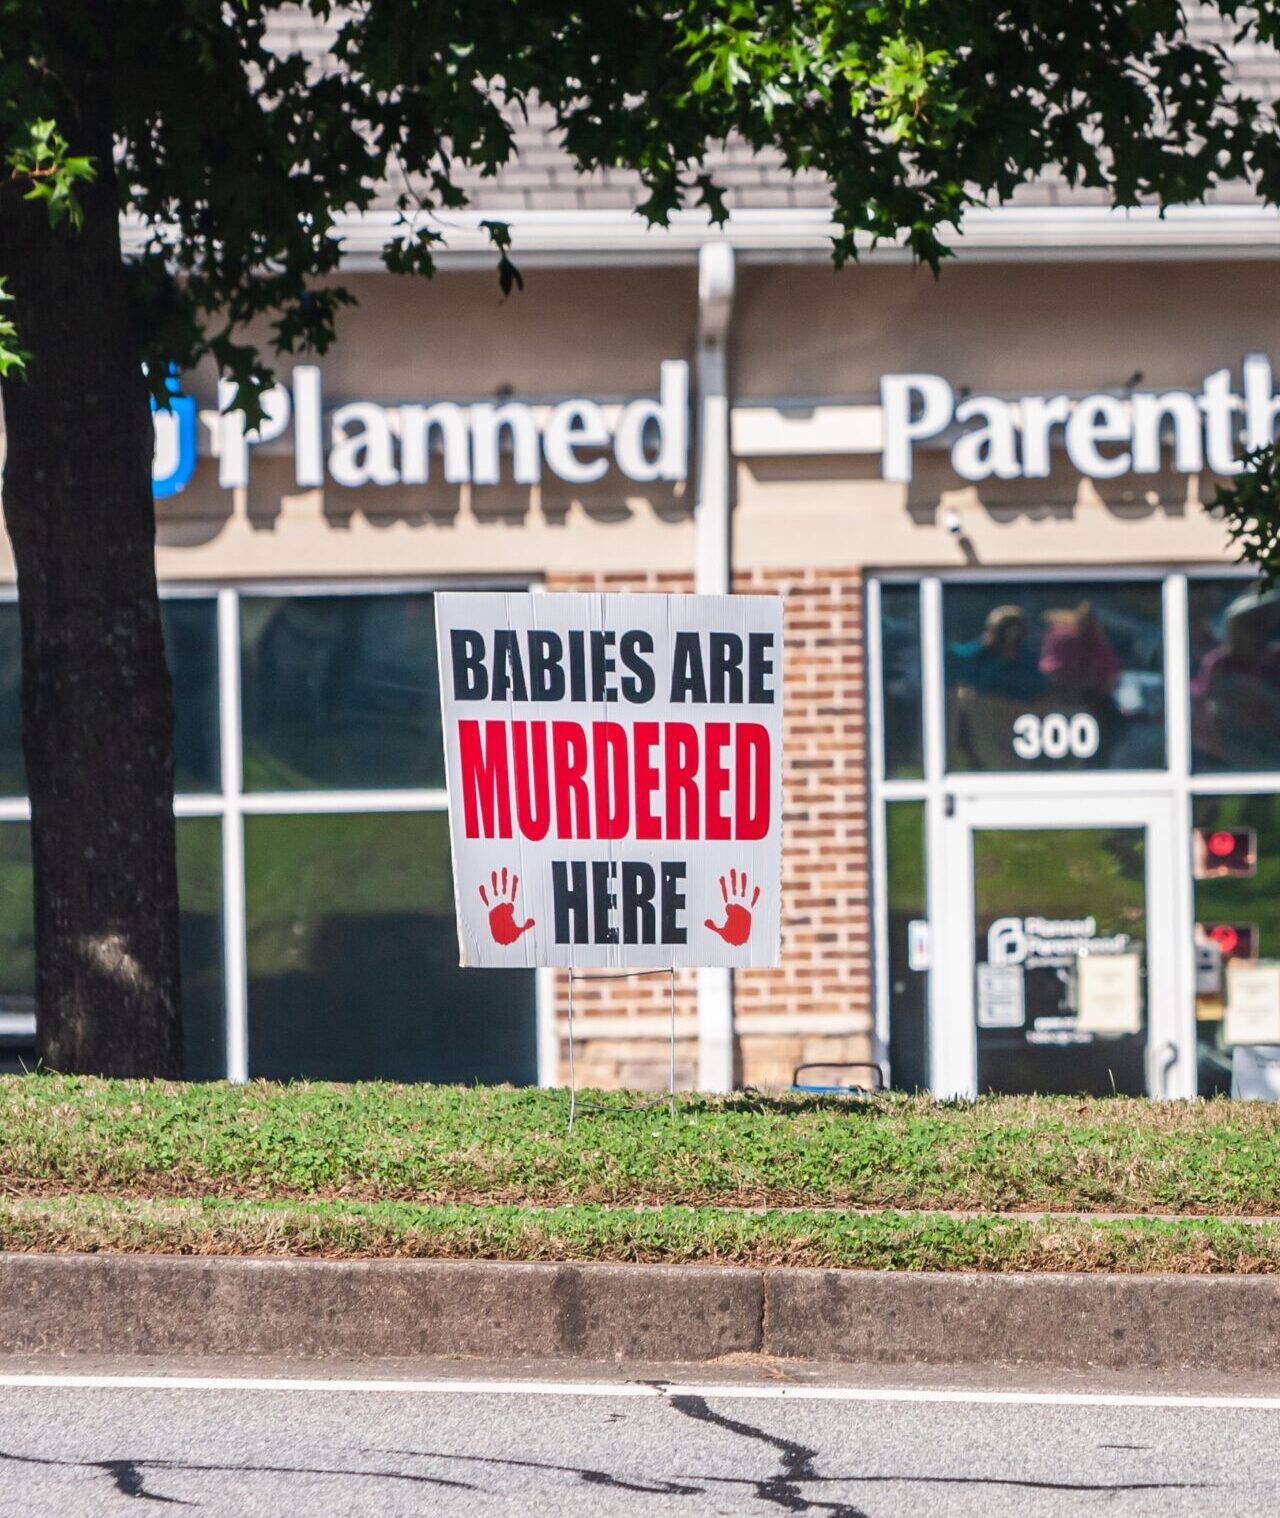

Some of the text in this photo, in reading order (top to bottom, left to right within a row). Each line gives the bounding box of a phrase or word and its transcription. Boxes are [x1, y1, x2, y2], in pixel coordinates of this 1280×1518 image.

[217, 359, 690, 489] Planned
[450, 629, 775, 704] BABIES ARE
[1012, 713, 1100, 760] 300
[458, 719, 771, 842] MURDERED
[551, 860, 688, 945] HERE
